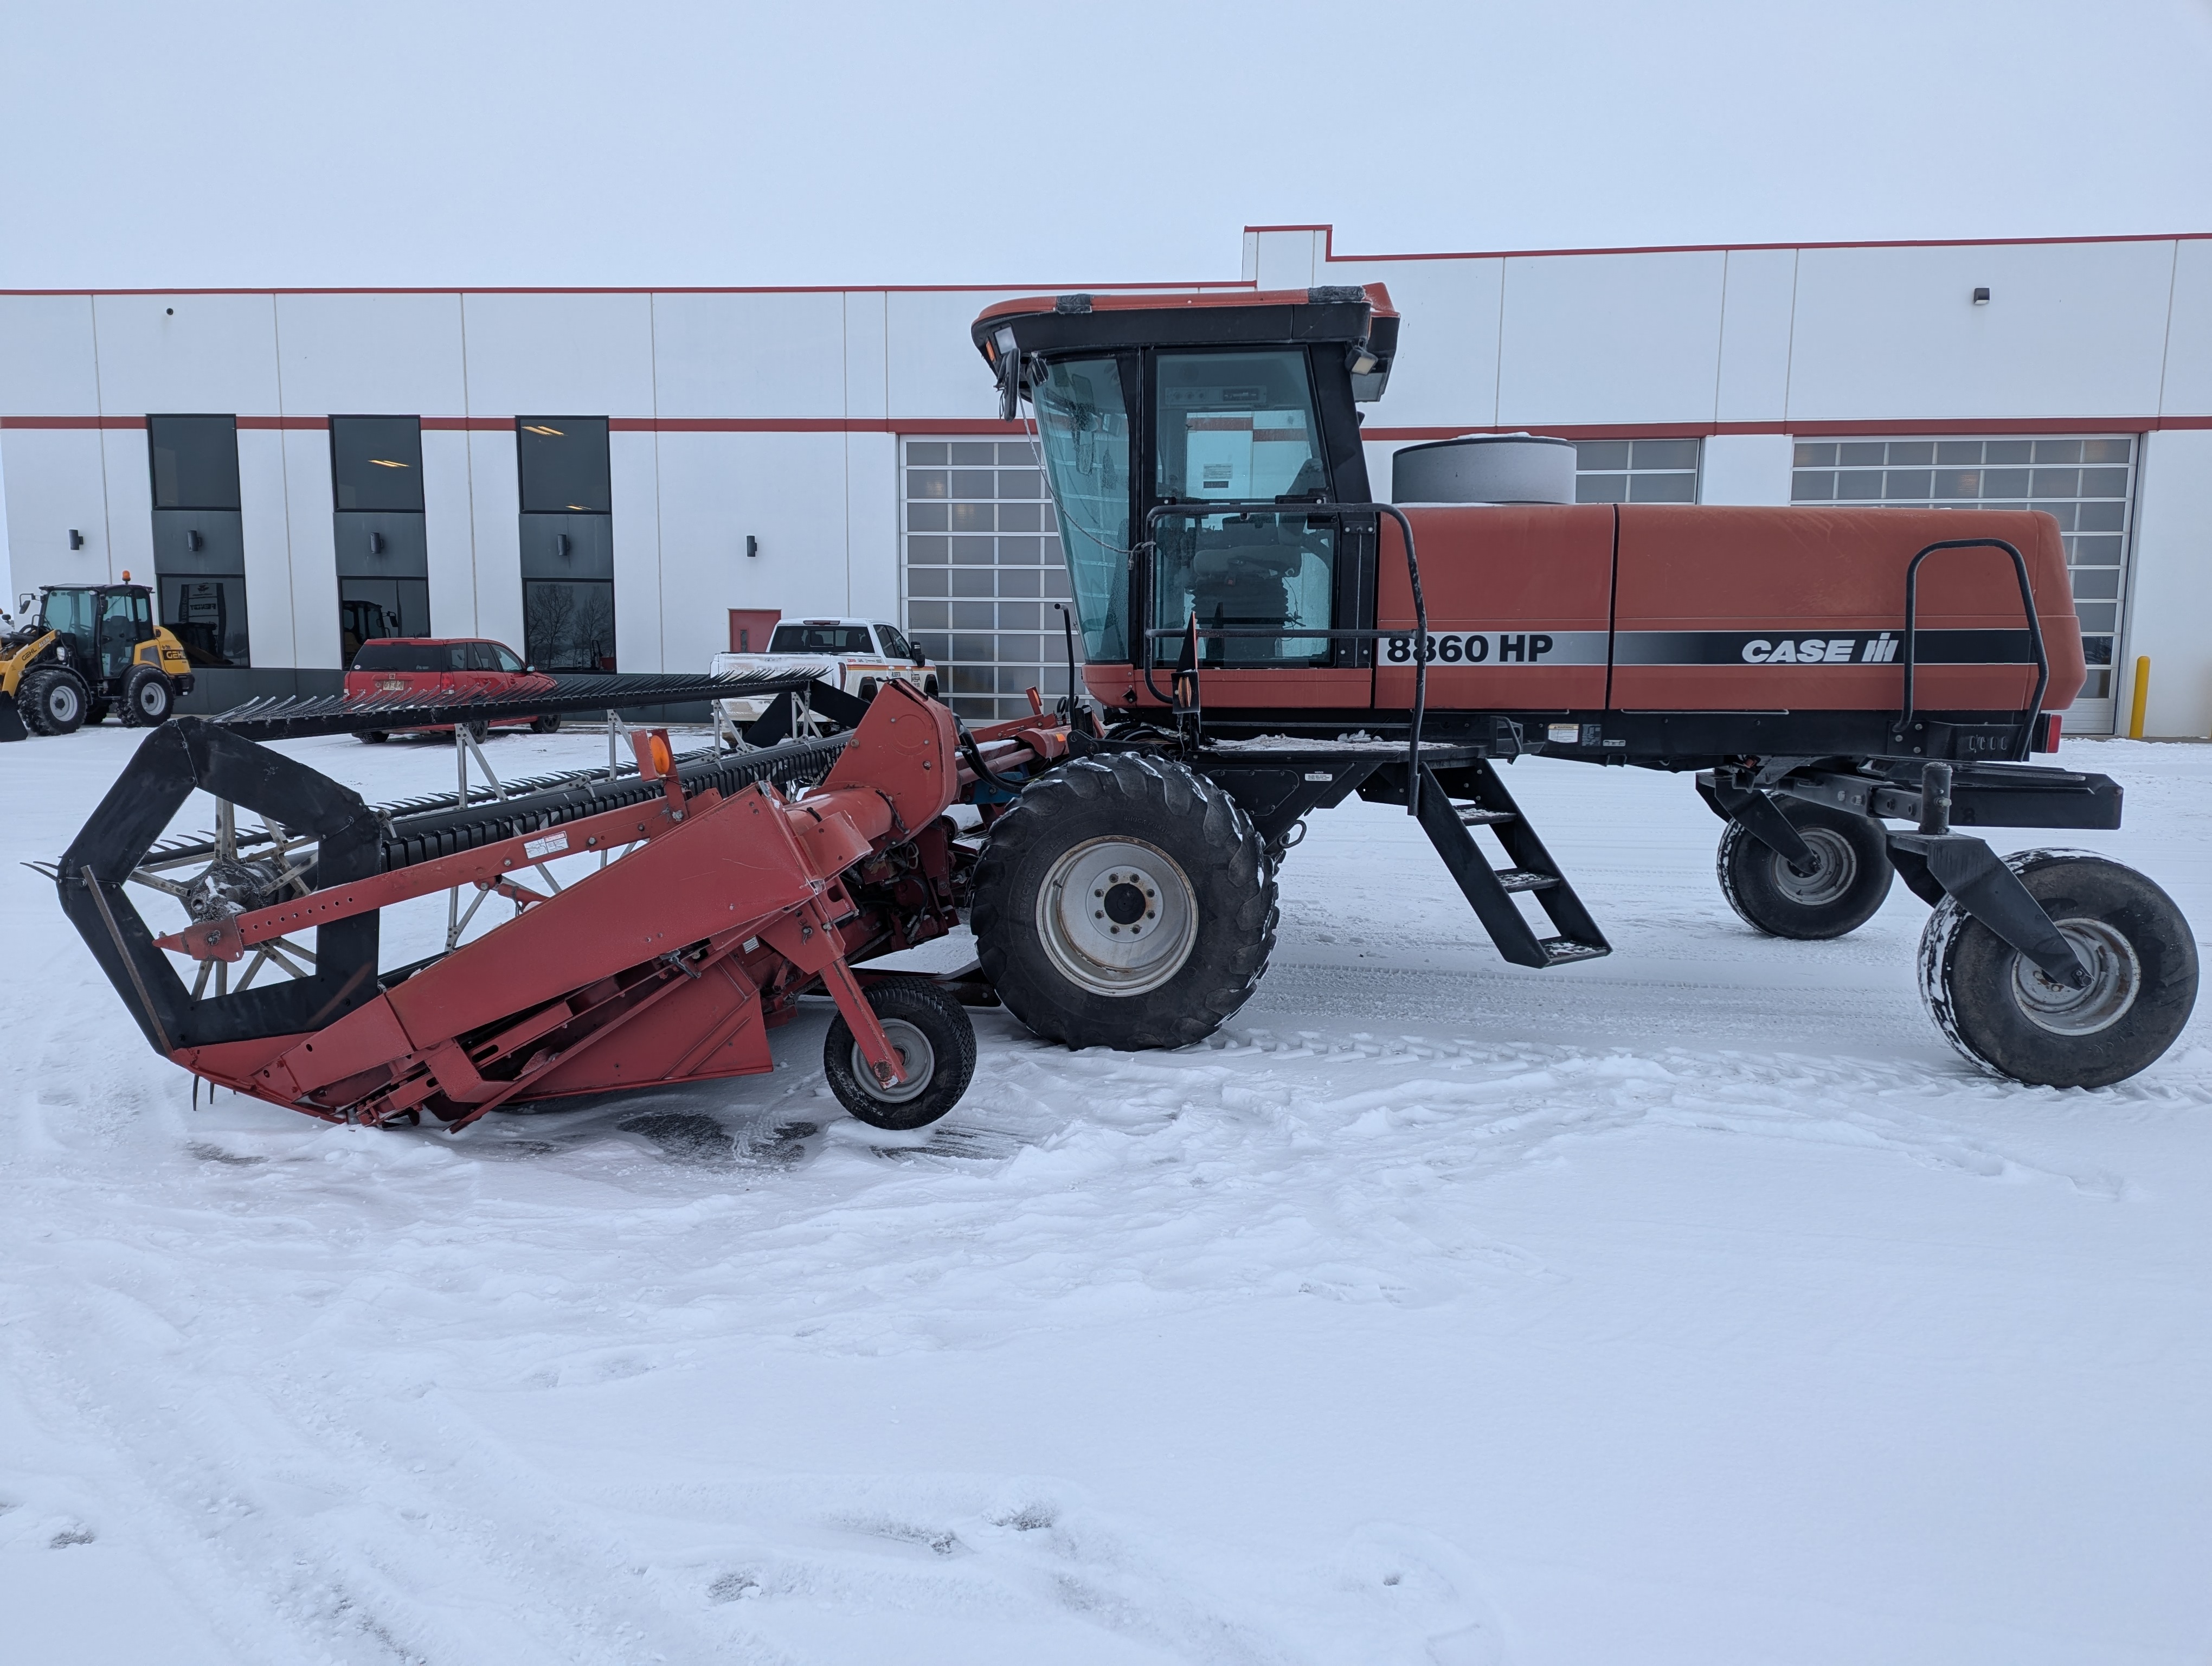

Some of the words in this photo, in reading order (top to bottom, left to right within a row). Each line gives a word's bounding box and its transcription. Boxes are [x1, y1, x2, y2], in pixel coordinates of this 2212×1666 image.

[22, 648, 37, 661] GEHL
[166, 651, 187, 659] GEHL
[1387, 635, 1489, 663] 8860
[1499, 635, 1553, 662] HP
[1741, 639, 1856, 663] CASE
[1123, 815, 1147, 825] SHOCK
[1019, 863, 1039, 916] TRACTION
[1038, 832, 1071, 862] UTILITY
